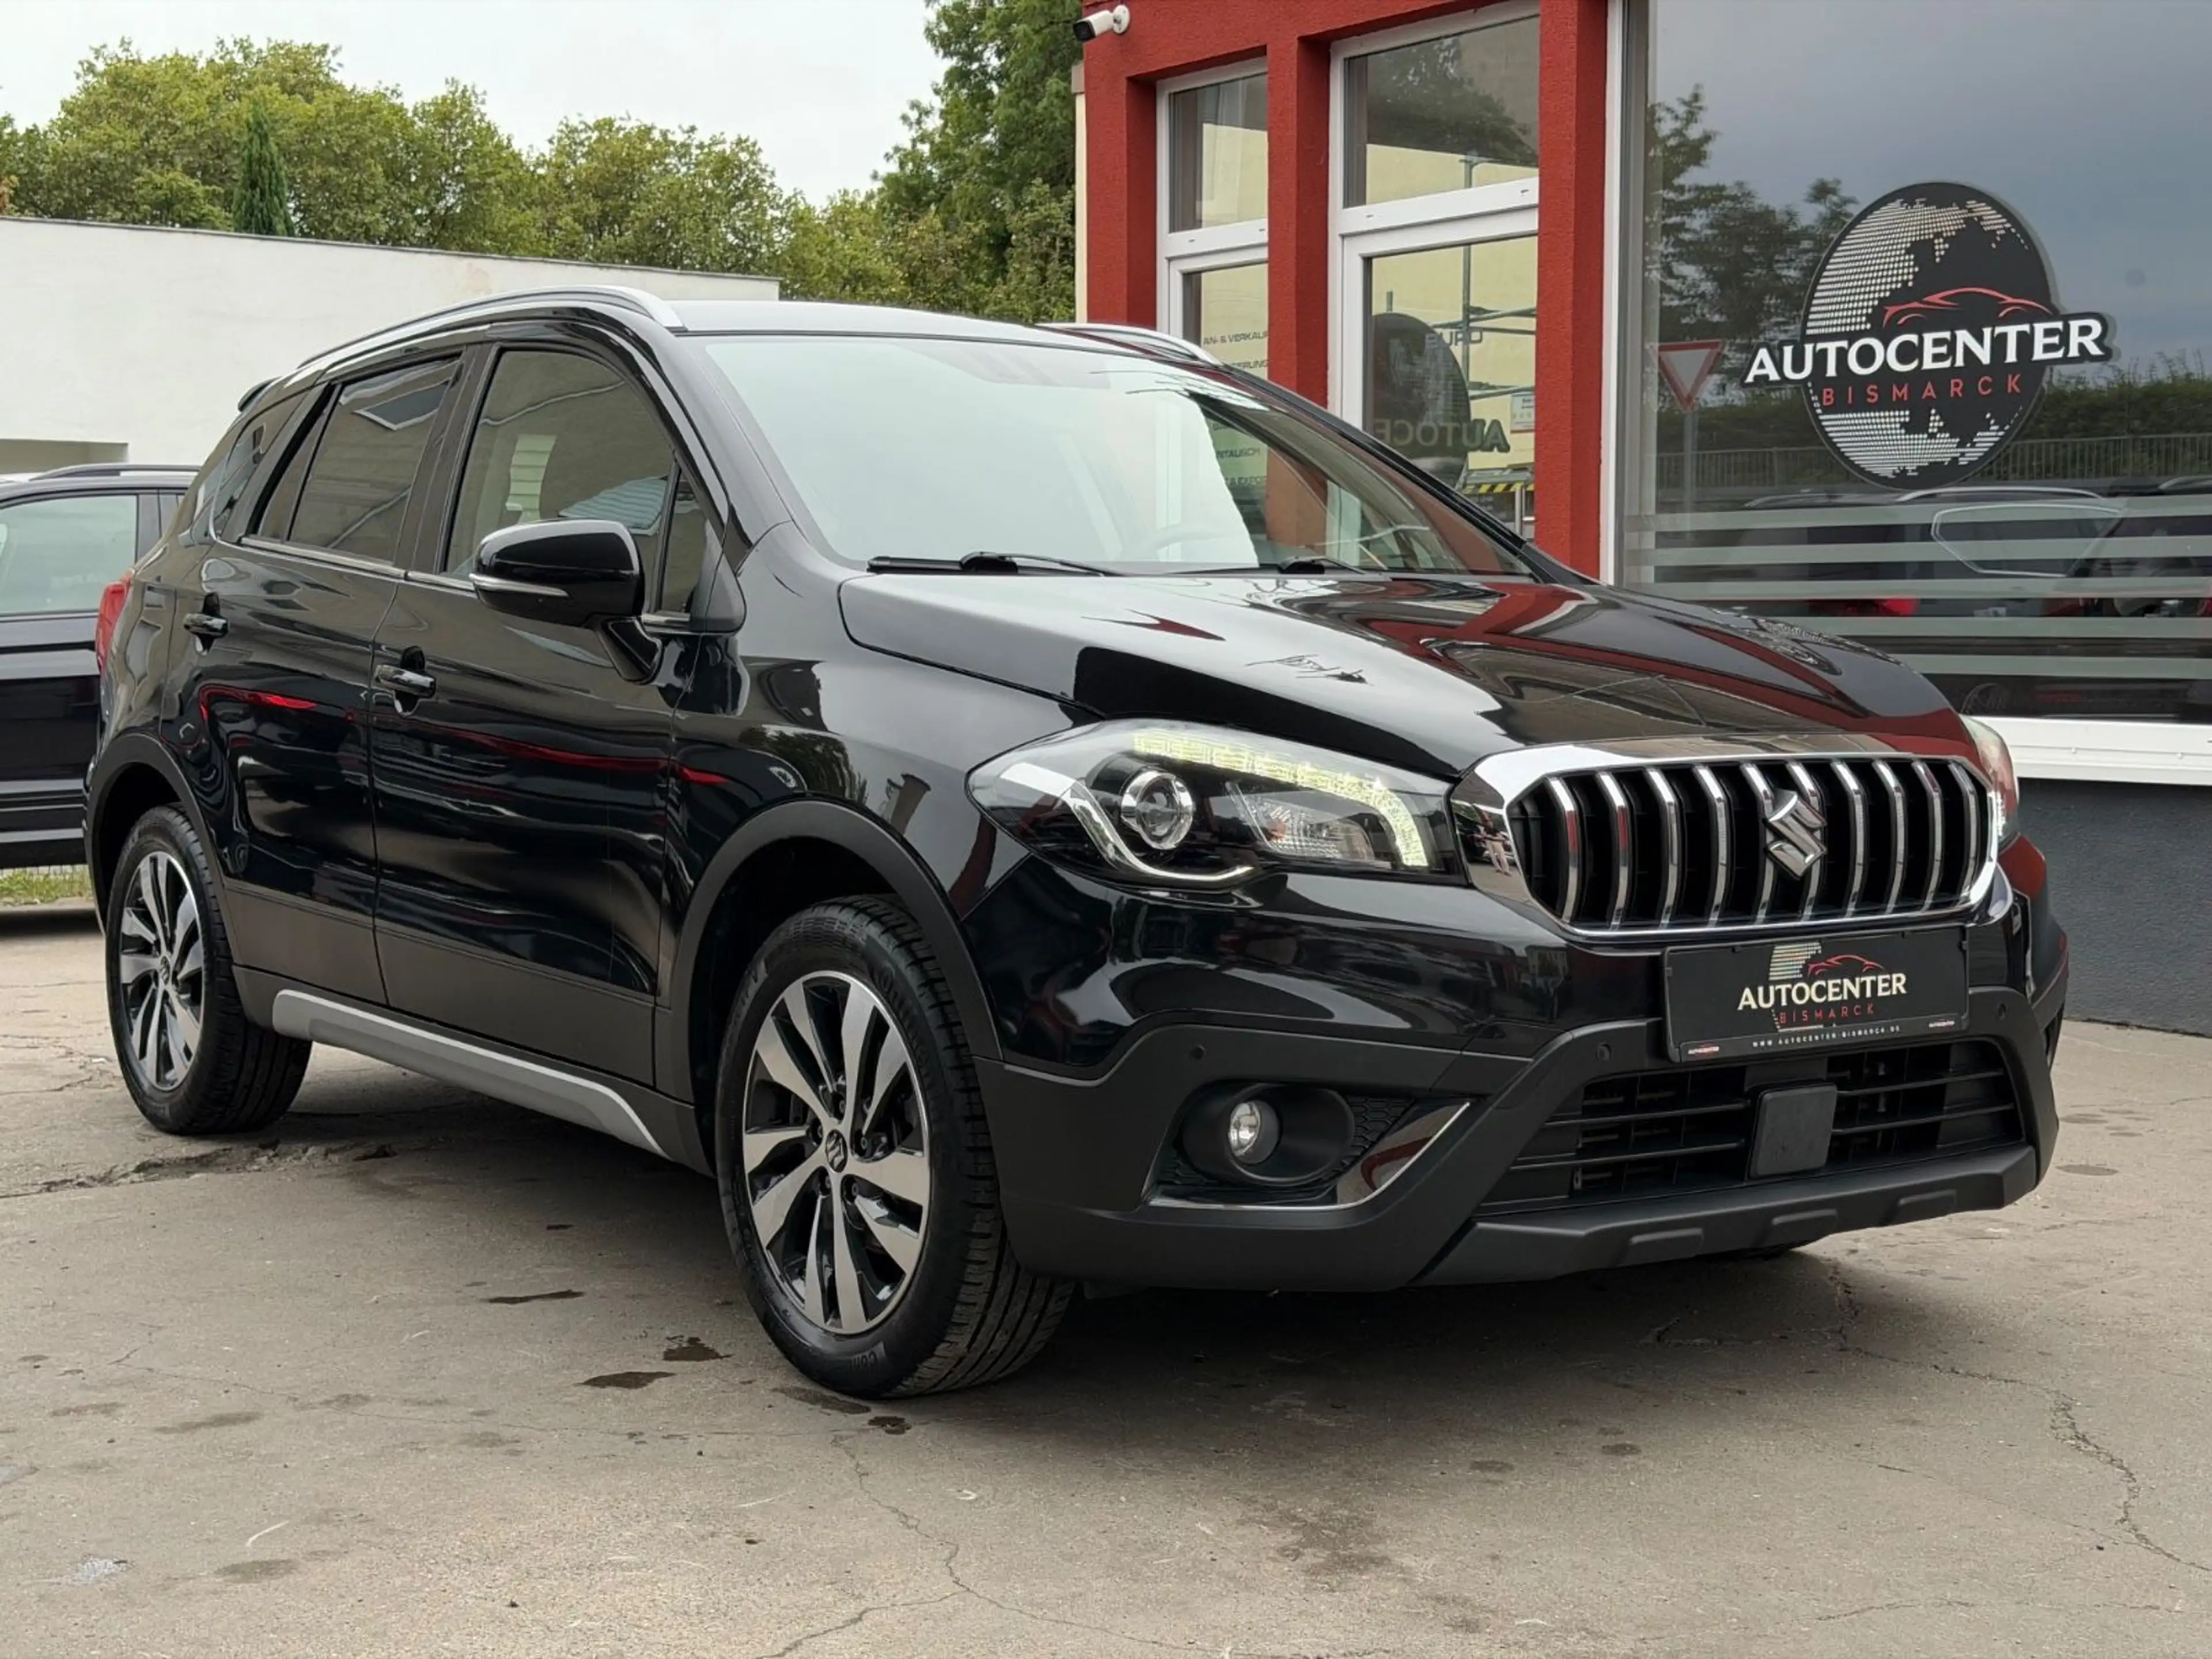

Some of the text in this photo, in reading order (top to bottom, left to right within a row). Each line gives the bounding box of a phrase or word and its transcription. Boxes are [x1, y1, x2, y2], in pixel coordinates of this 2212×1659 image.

[1744, 319, 2105, 384] AUTOCENTER
[1822, 374, 2021, 406] BISMARCK
[1737, 973, 1907, 1011] AUTOCENTER
[1779, 1002, 1875, 1024] BISMARCK
